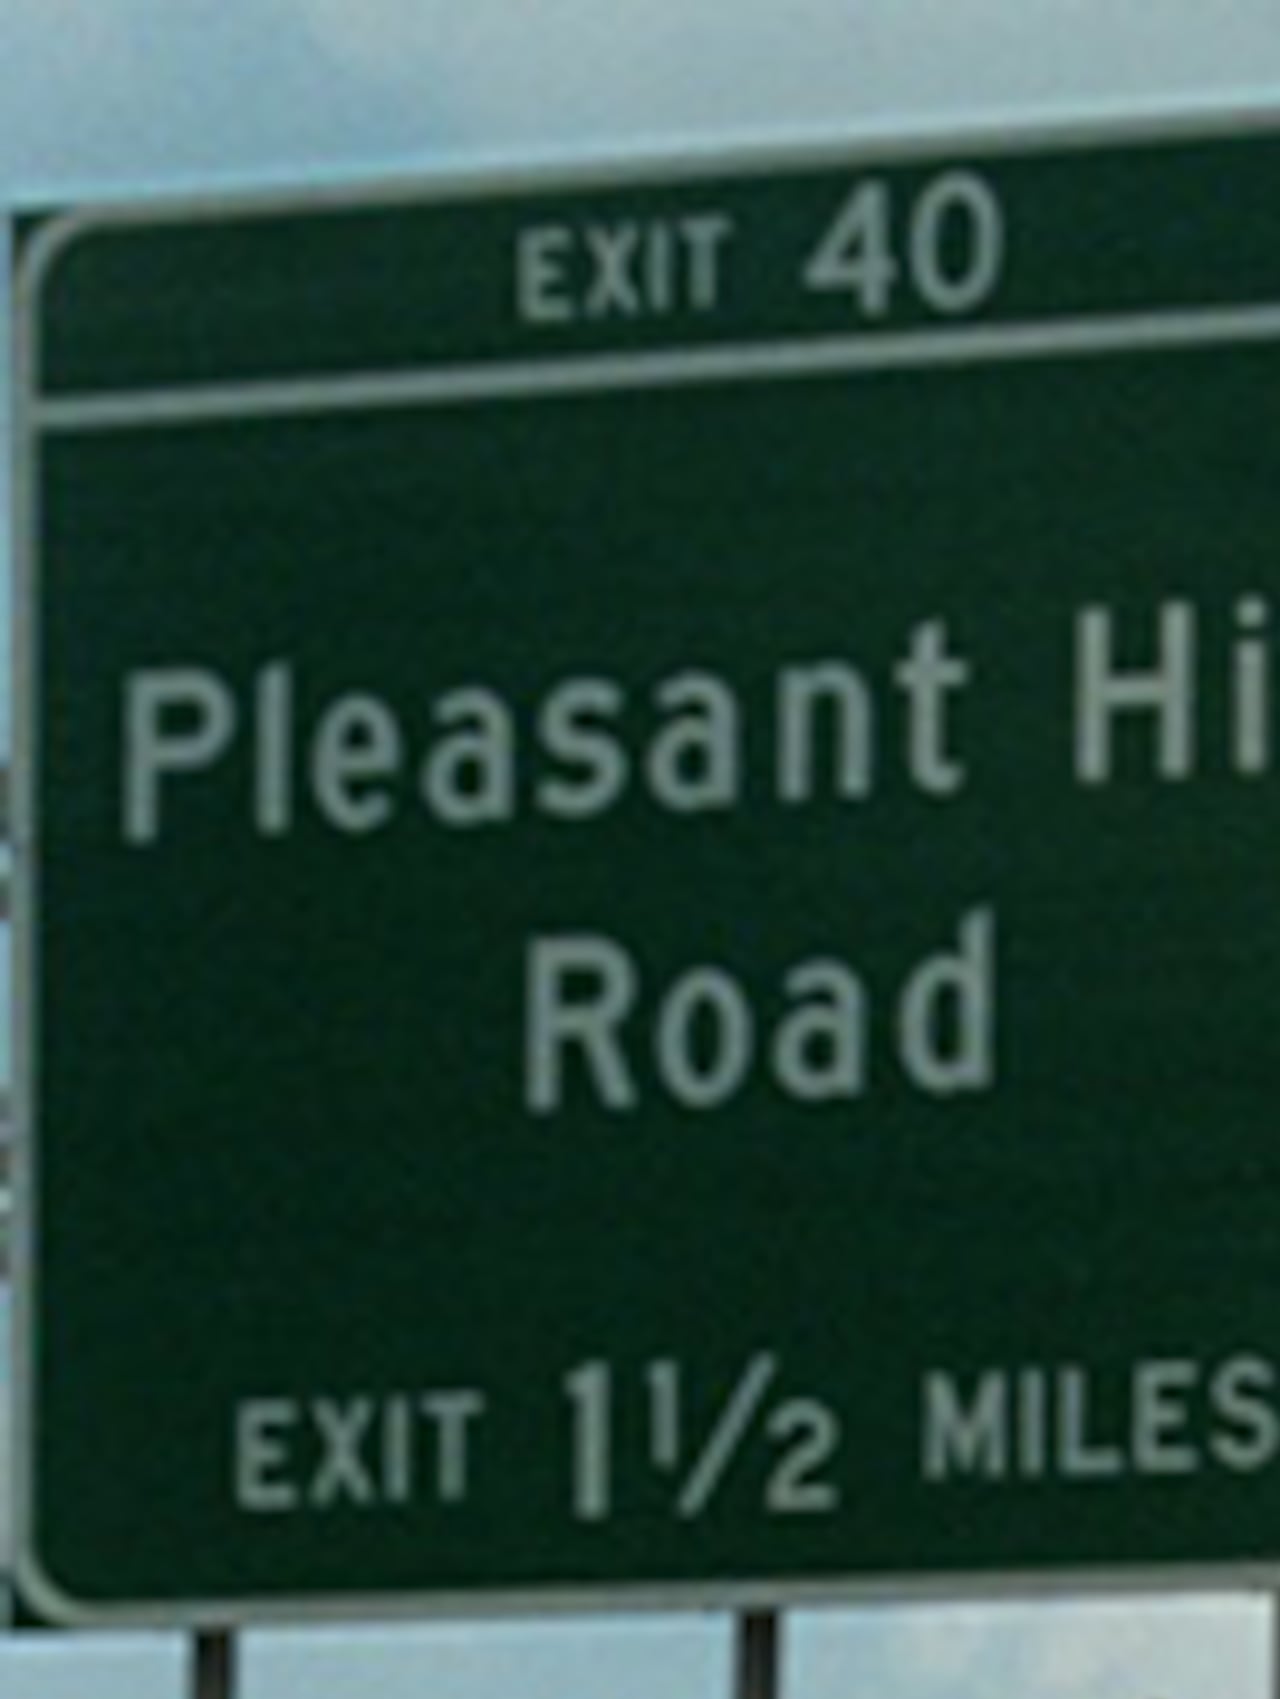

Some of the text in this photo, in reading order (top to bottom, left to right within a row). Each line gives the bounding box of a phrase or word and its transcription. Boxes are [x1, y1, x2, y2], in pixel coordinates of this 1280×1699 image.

[517, 168, 1003, 323] EXIT 40
[124, 619, 970, 843] Pleasant
[526, 907, 993, 1112] Road
[235, 1389, 484, 1511] EXIT
